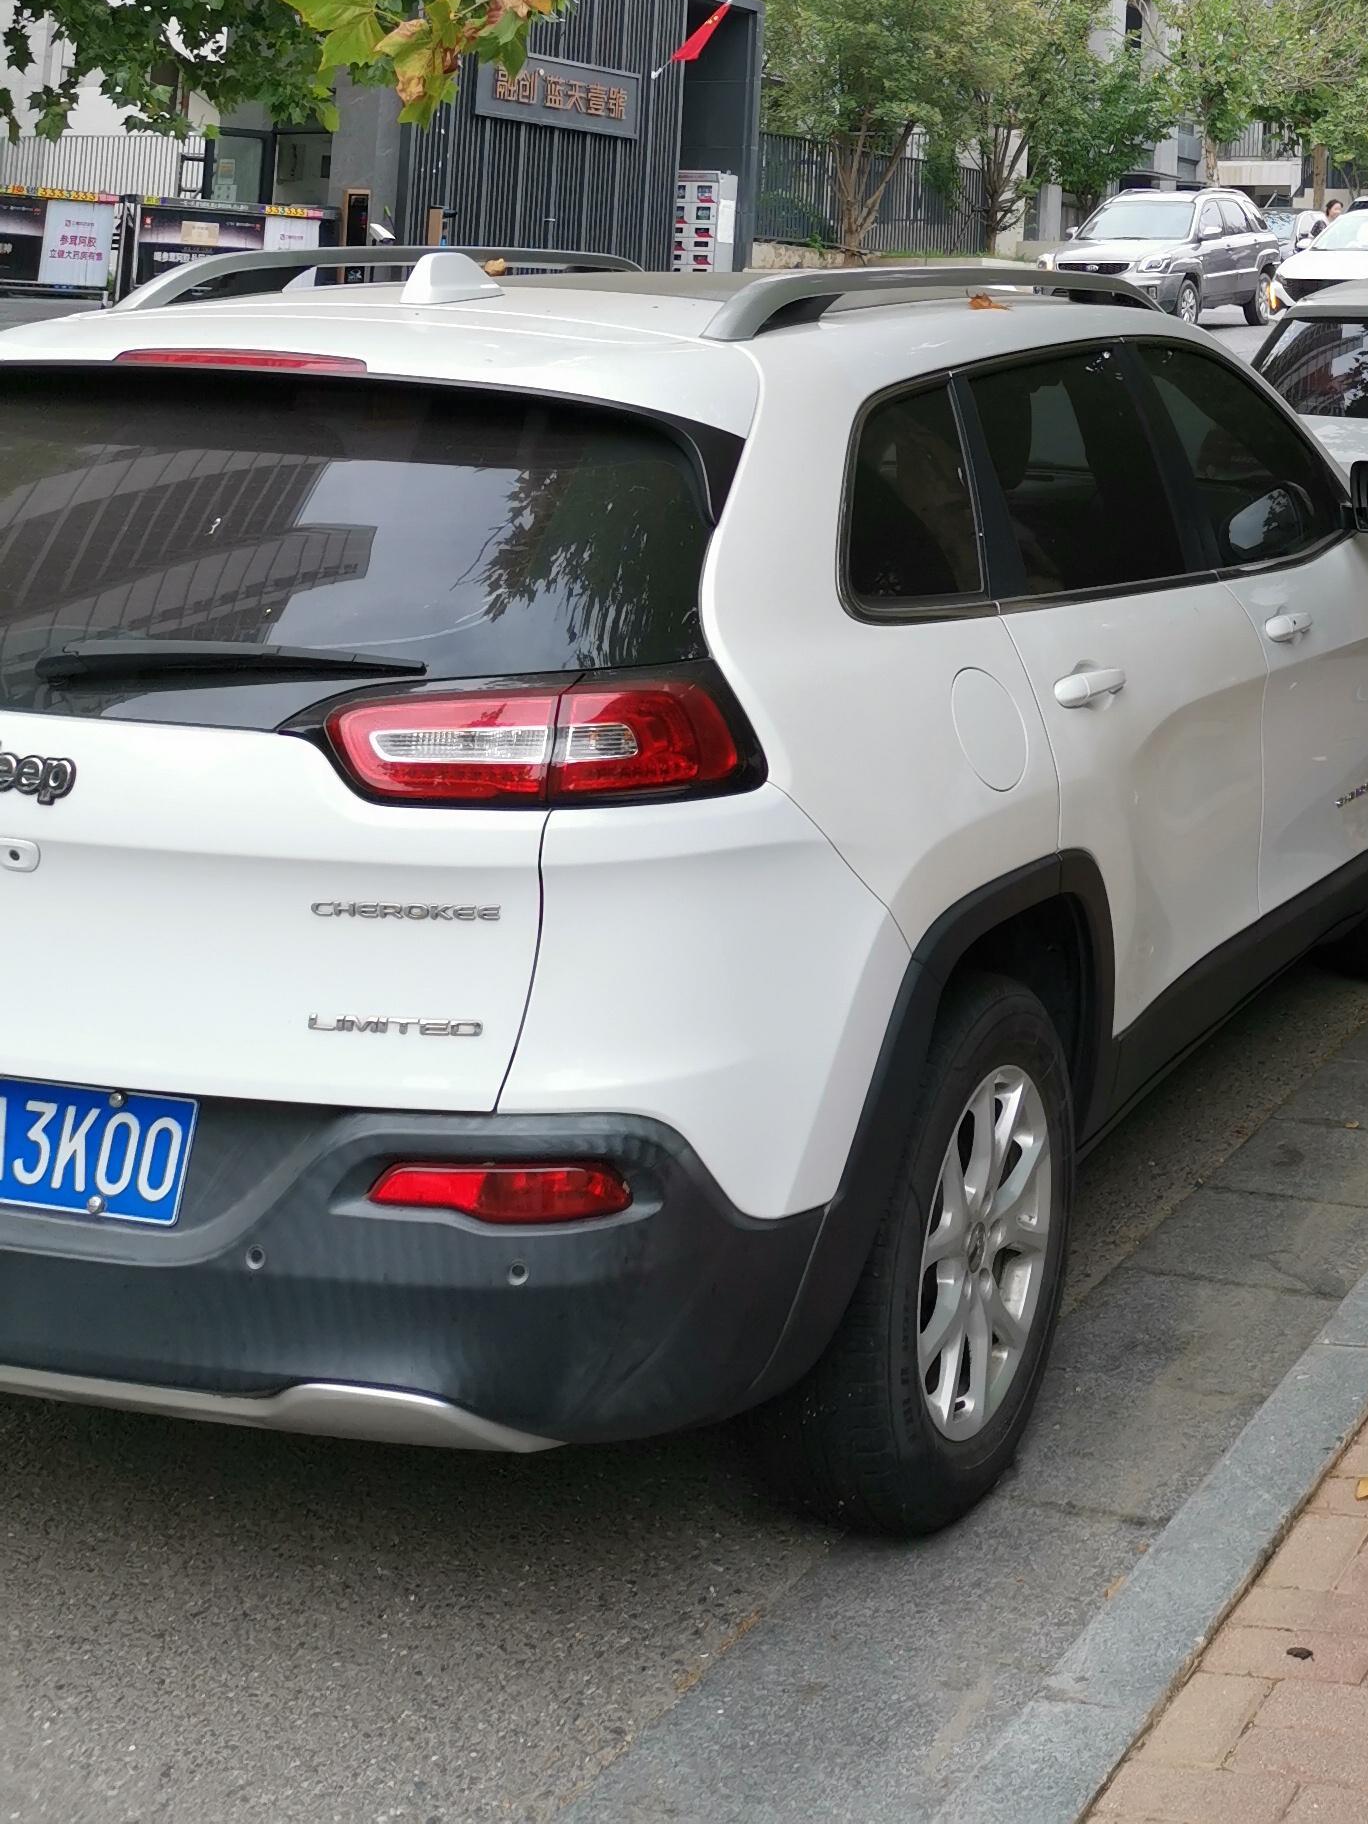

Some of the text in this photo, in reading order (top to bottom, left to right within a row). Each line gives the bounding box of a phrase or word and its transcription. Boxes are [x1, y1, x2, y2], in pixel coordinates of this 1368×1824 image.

[0, 740, 76, 805] eep
[310, 902, 501, 921] CHEROKEE
[308, 1013, 484, 1036] LIMITED
[0, 1096, 183, 1202] 3K00
